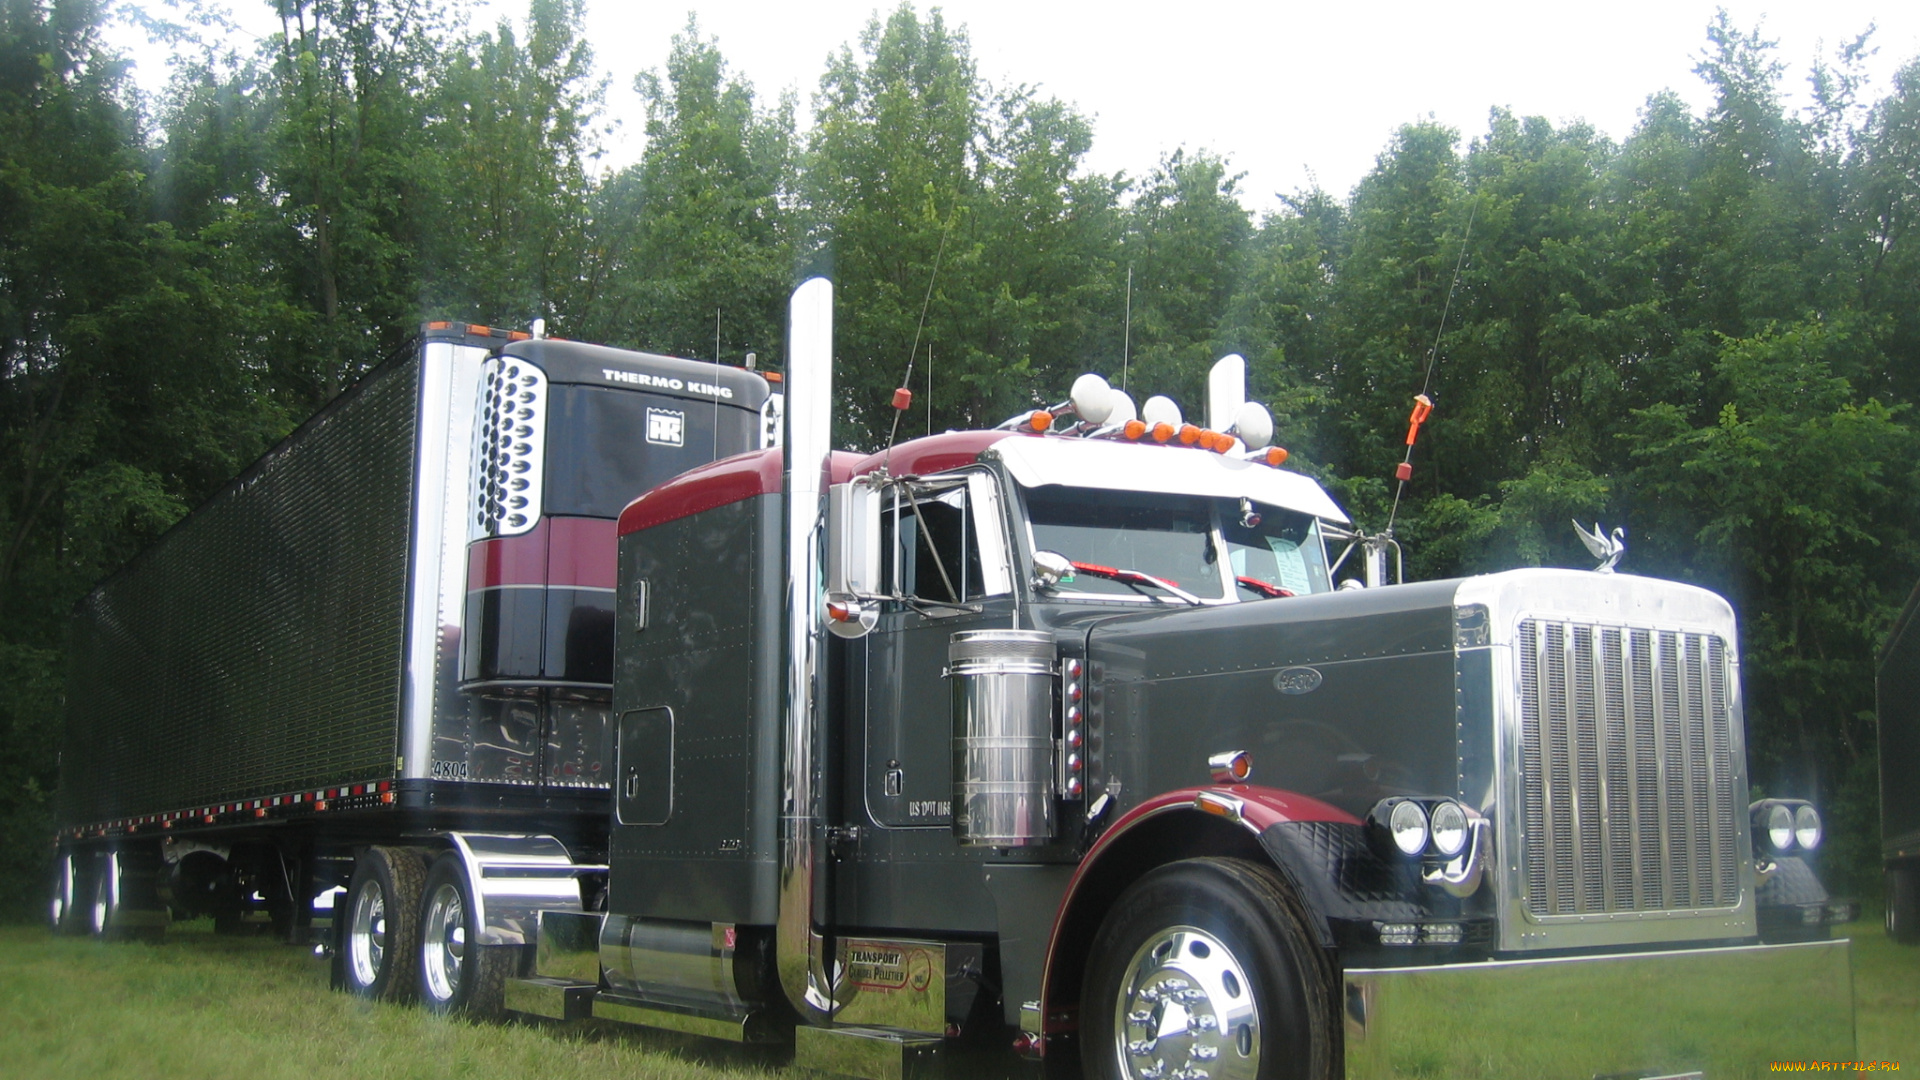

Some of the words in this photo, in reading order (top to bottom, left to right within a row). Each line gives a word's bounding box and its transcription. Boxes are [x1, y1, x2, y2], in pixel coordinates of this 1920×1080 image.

[602, 369, 683, 390] THERMO
[687, 381, 733, 398] KING
[433, 760, 468, 778] 4804
[909, 801, 920, 817] US
[921, 801, 936, 816] DOT
[851, 951, 901, 966] TRANSPORT
[873, 966, 904, 982] PELLETIER
